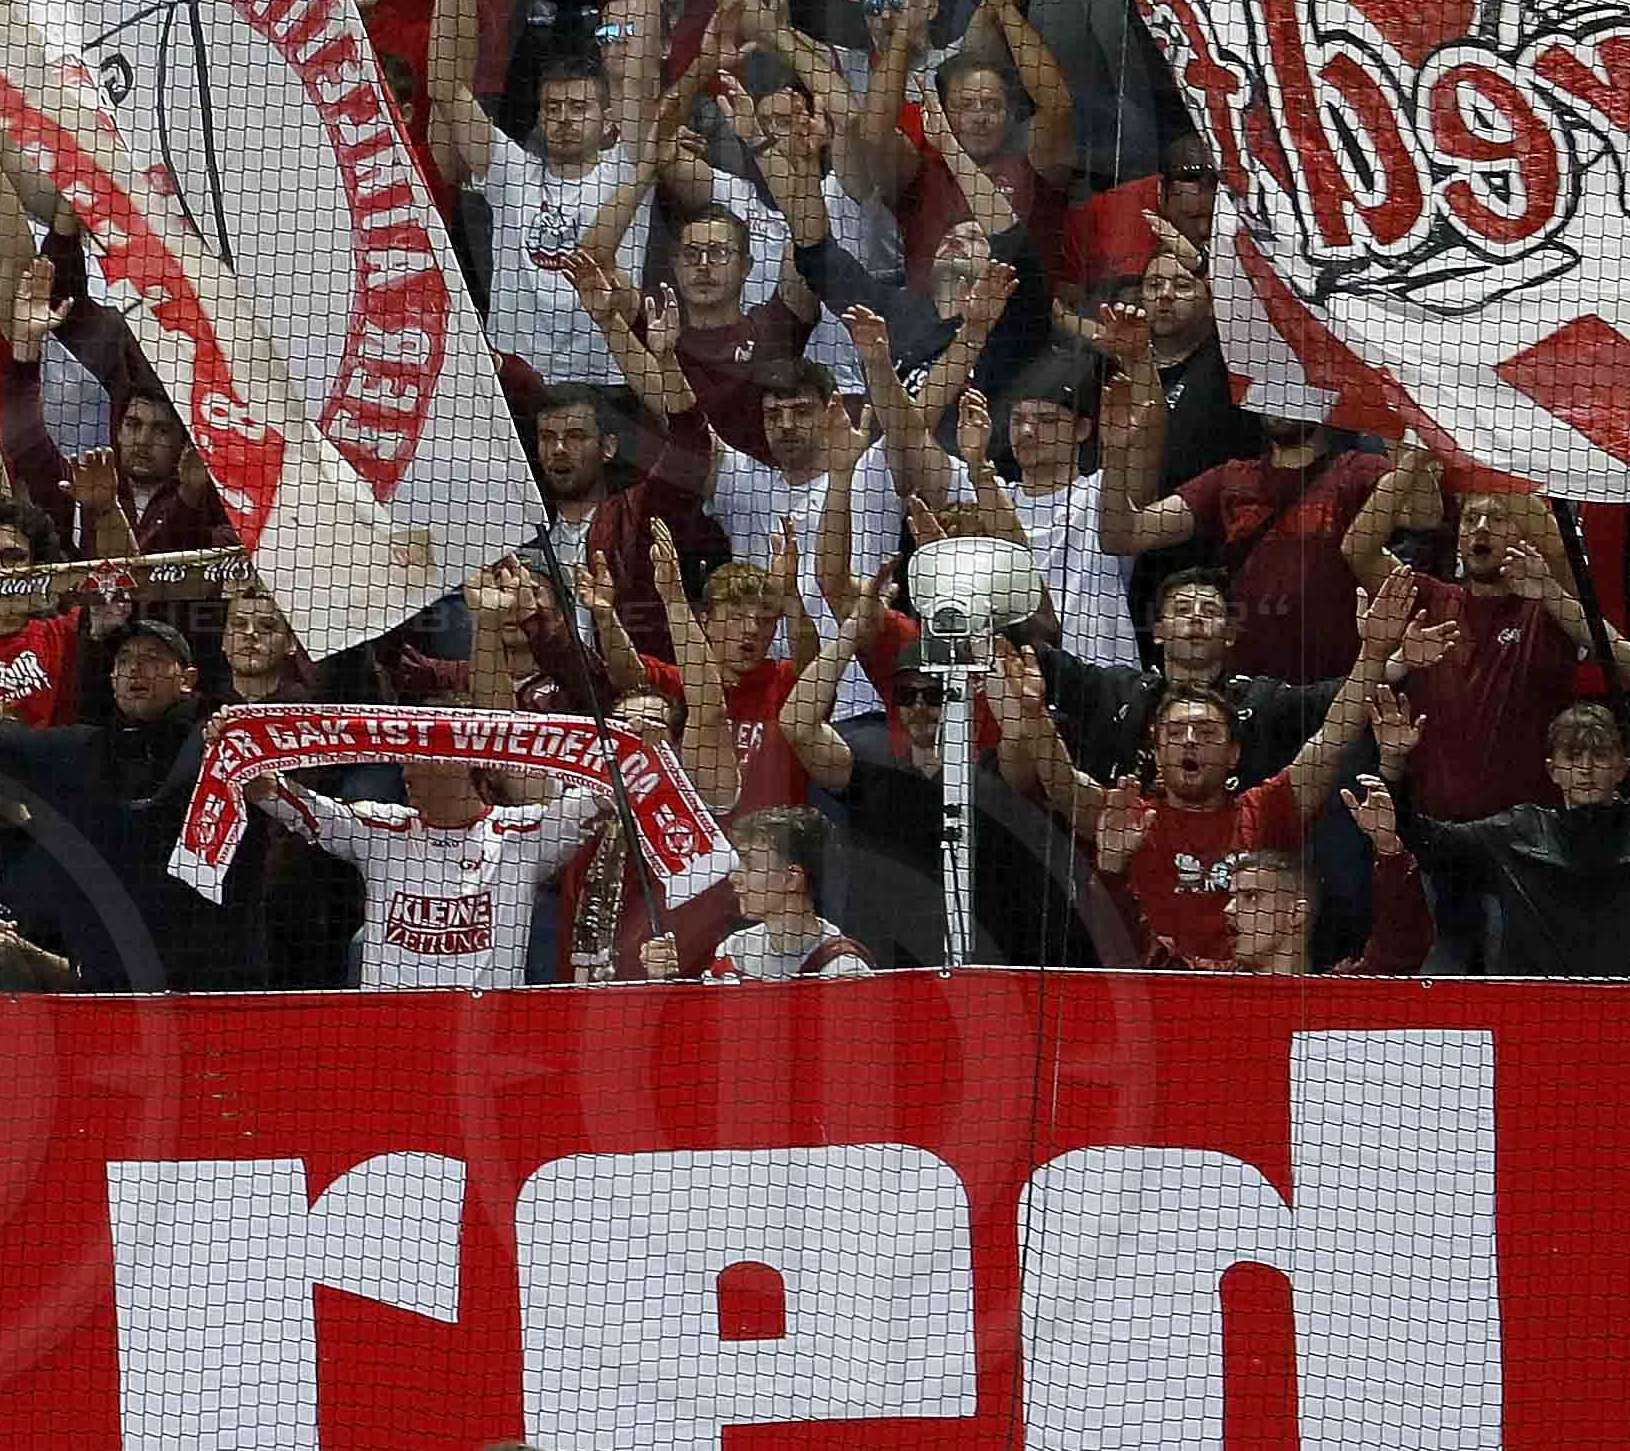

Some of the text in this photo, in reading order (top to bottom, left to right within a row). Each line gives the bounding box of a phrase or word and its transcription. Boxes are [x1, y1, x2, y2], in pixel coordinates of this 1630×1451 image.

[265, 720, 357, 750] GAK
[369, 718, 433, 748] IST
[451, 720, 623, 776] WIEDER
[392, 892, 491, 926] KLEINE
